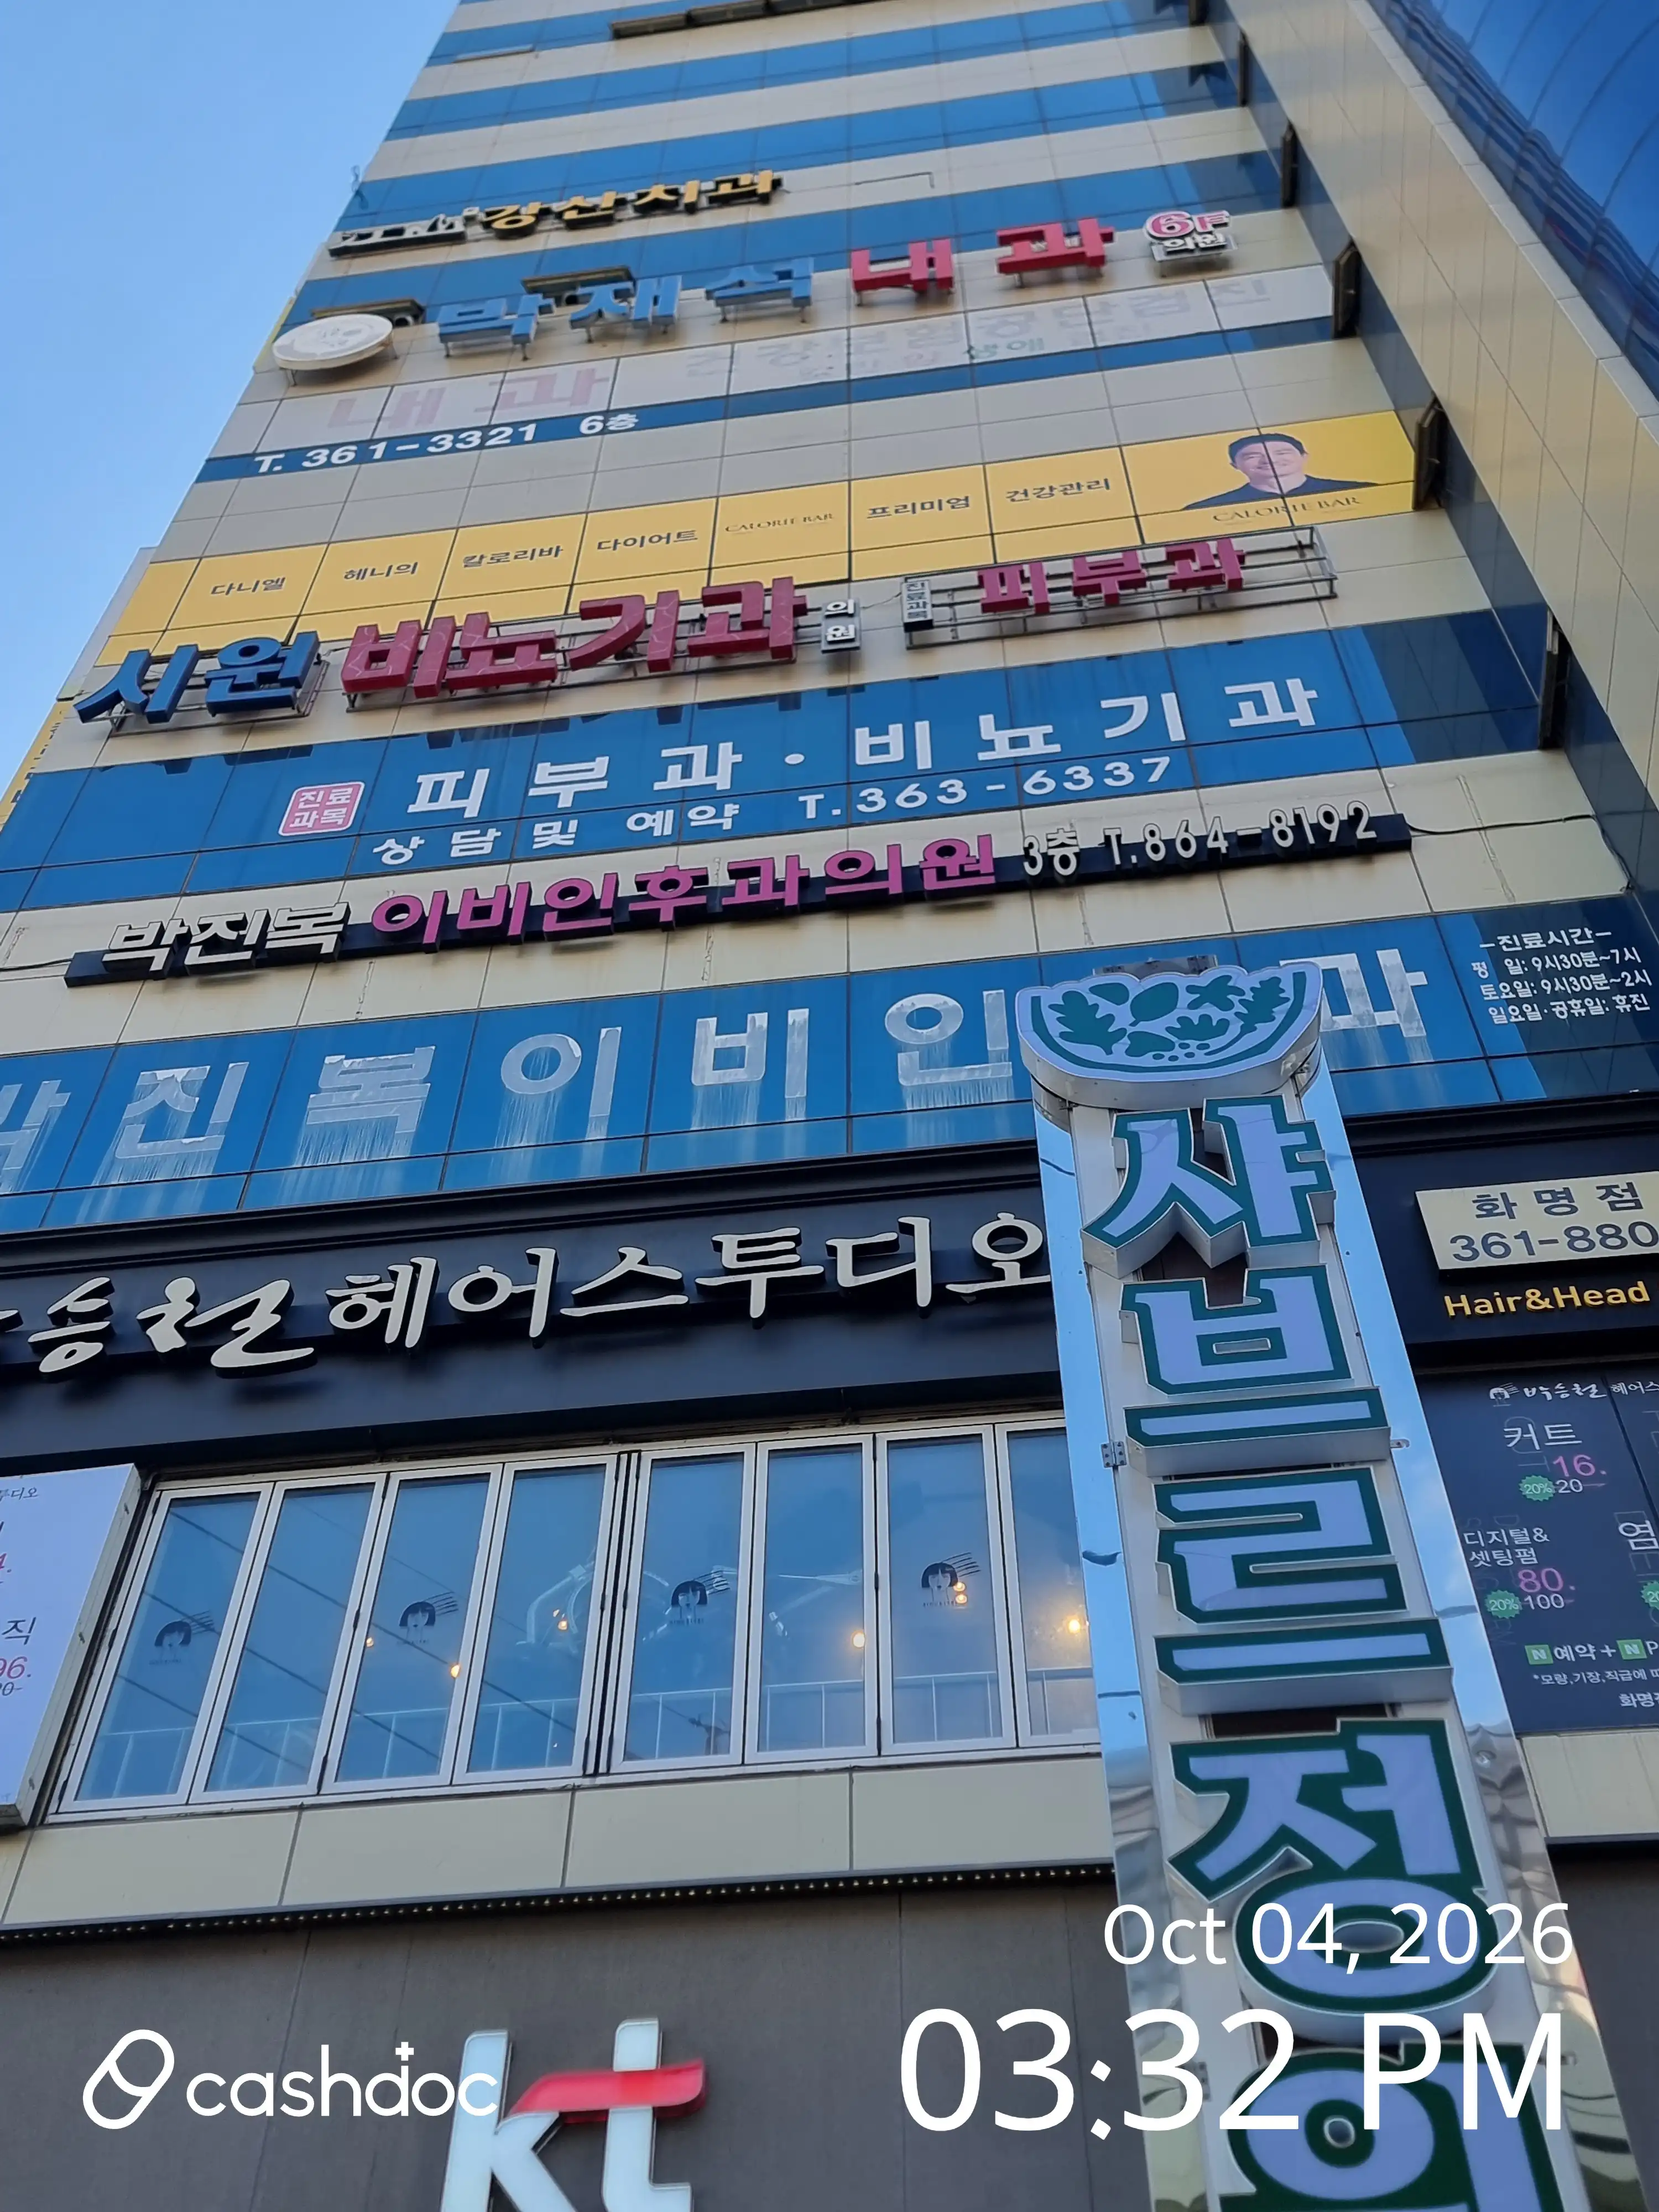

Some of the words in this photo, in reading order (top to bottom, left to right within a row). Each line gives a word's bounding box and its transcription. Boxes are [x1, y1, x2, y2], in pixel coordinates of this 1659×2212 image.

[482, 169, 779, 234] 강산치과
[1146, 210, 1230, 238] 6F
[851, 217, 1115, 291] 내과
[1164, 233, 1227, 251] 의원
[328, 367, 609, 429] 내과
[301, 424, 538, 468] 361-3321
[580, 413, 639, 435] 6층
[1005, 477, 1112, 503] 건강관리
[867, 495, 971, 520] 프리미엄
[1317, 497, 1361, 509] BAR
[597, 530, 698, 551] 다이어트
[462, 545, 564, 568] 칼로리바
[343, 561, 419, 582] 헤니의
[977, 538, 1245, 614] 피부과
[210, 577, 286, 597] 다니엘
[73, 631, 320, 723] 시원
[341, 577, 808, 698] 비뇨기과
[825, 599, 856, 643] 의원
[406, 742, 743, 818] 피부과
[854, 677, 1318, 771] 비뇨기과
[298, 787, 353, 809] 진료
[289, 807, 347, 828] 과목
[626, 803, 740, 837] 예약
[102, 901, 351, 974] 박진복
[372, 834, 996, 947] 이비인후과의원
[1023, 828, 1079, 877] 3층
[1103, 801, 1377, 865] T.864-8192
[1612, 993, 1651, 1013] 휴진
[1472, 1182, 1644, 1219] 화명점
[0, 1276, 315, 1374] 승철
[326, 1212, 1051, 1348] 헤어스투디오
[1444, 1281, 1650, 1318] Hair&Head
[1523, 1383, 1607, 1401] 박승철
[1504, 1423, 1582, 1450] 커트
[1524, 1483, 1552, 1495] 20%
[1557, 1478, 1583, 1494] 20
[1463, 1527, 1550, 1547] 디지털&
[1469, 1547, 1538, 1568] 셋팅펌
[1489, 1599, 1520, 1611] 20%
[1524, 1594, 1565, 1610] 100
[1553, 1643, 1597, 1662] 예약
[440, 2017, 707, 2212] kt
